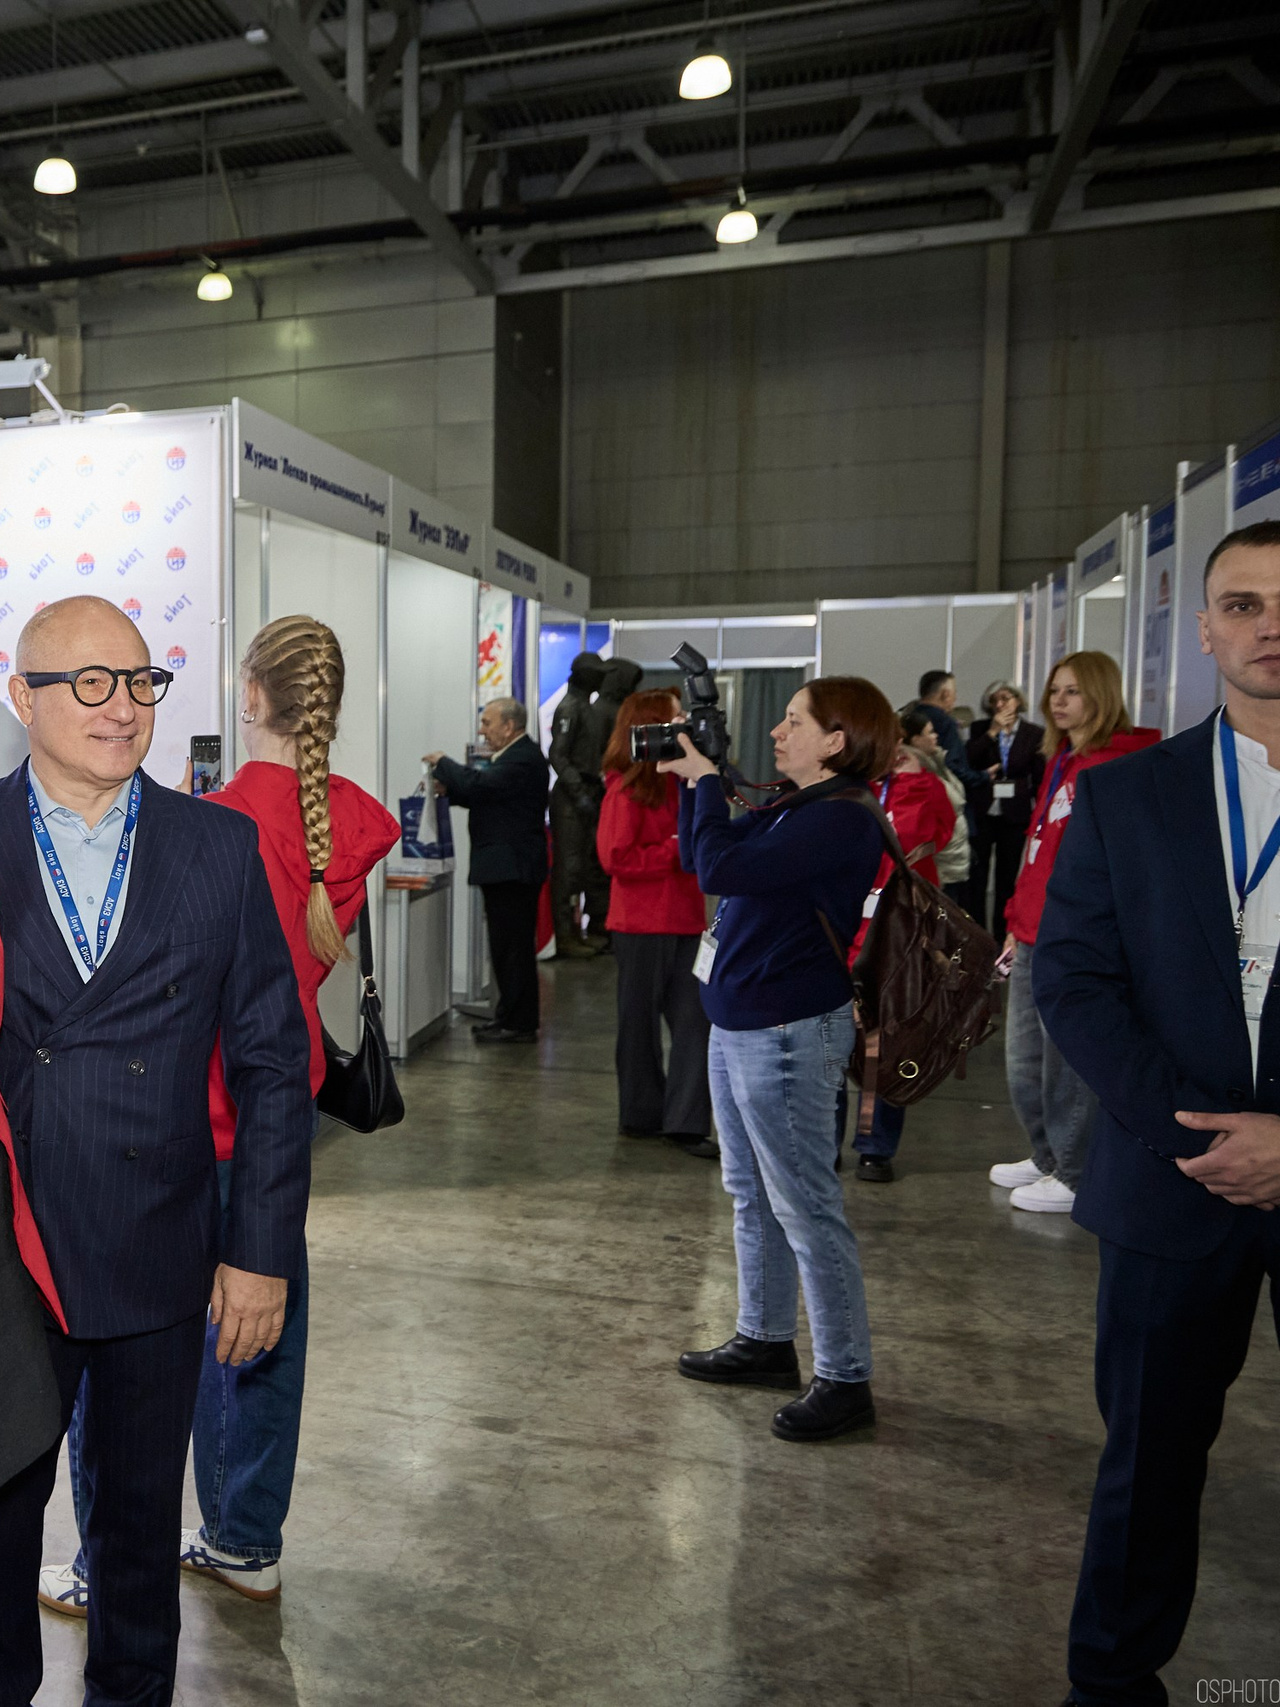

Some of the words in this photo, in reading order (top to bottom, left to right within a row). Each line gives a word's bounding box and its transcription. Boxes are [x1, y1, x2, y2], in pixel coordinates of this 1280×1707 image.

[56, 879, 70, 898] АСИЗ
[103, 896, 114, 917] АСИЗ
[80, 946, 94, 966] АСИЗ
